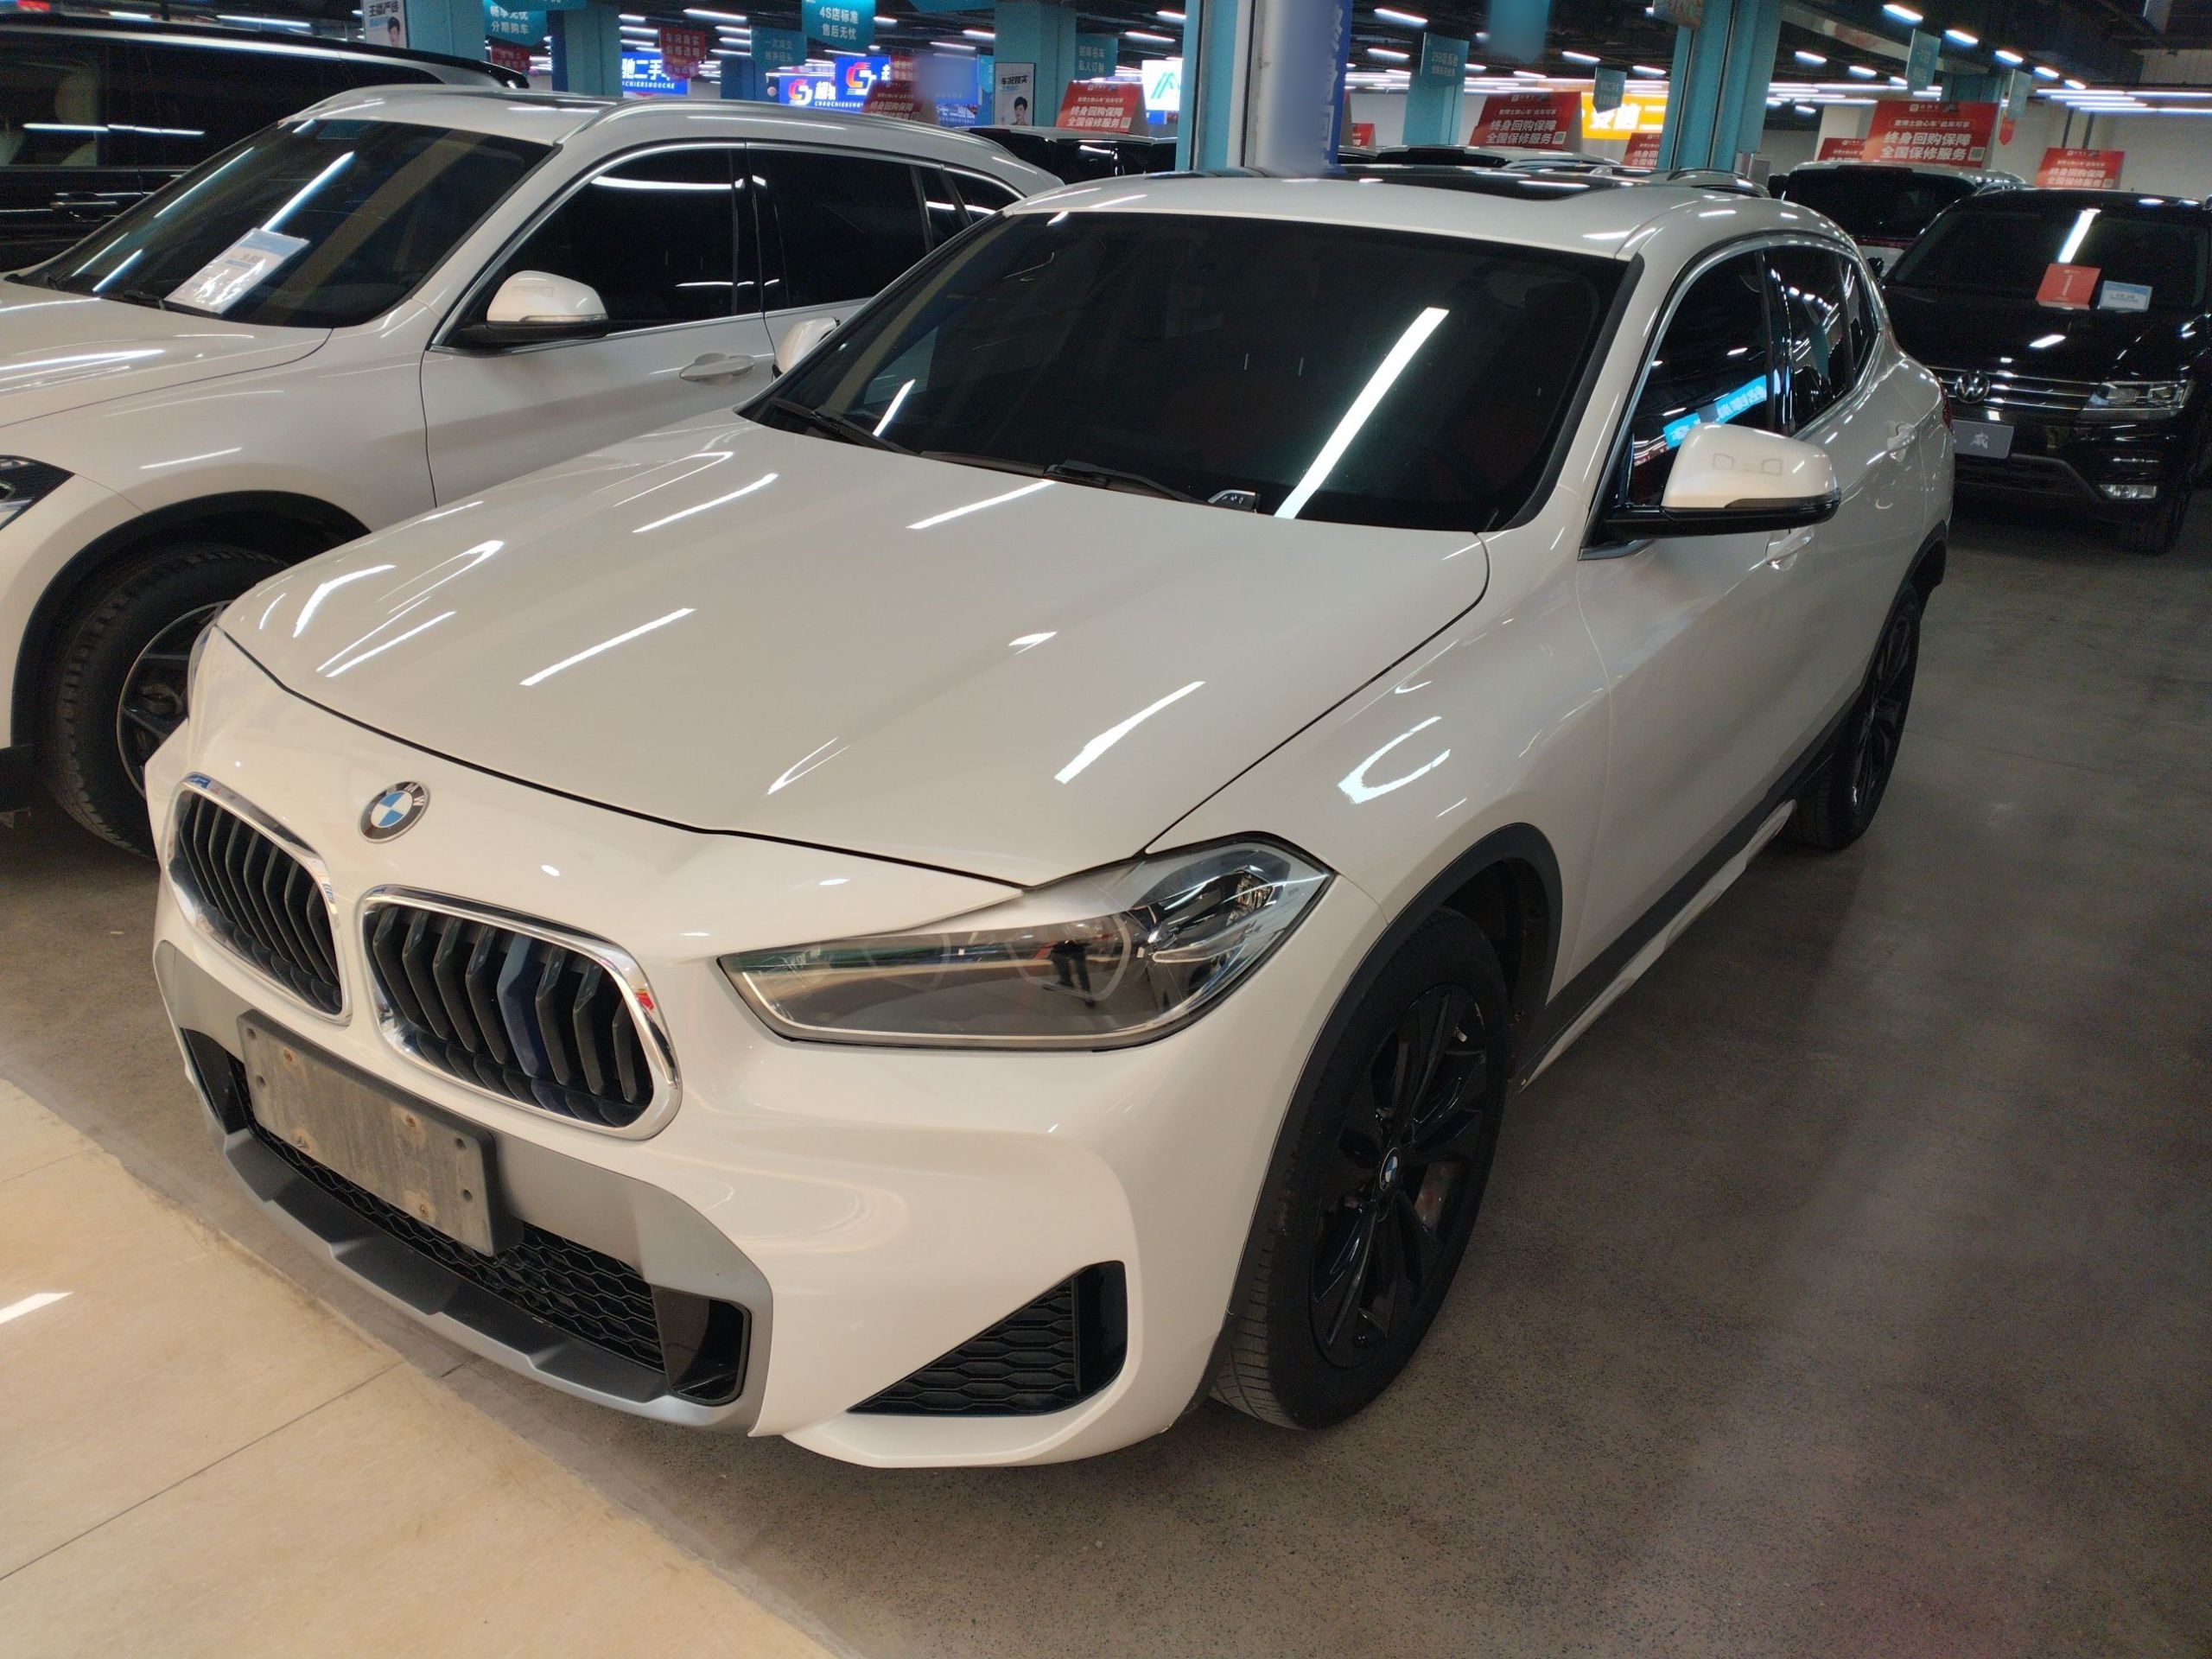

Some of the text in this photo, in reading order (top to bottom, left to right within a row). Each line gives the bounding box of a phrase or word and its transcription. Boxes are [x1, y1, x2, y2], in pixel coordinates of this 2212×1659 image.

[819, 7, 859, 24] 4S店标准
[822, 23, 856, 40] 售后无忧
[1071, 105, 1123, 117] 终身回购保障
[1067, 117, 1120, 128] 全国保修服务
[1490, 120, 1557, 130] 终身回购保障
[1486, 132, 1553, 144] 全国保修服务
[1884, 130, 1972, 146] 终身回购保障
[1880, 146, 1967, 160] 全国保修服务
[385, 781, 425, 806] BMW
